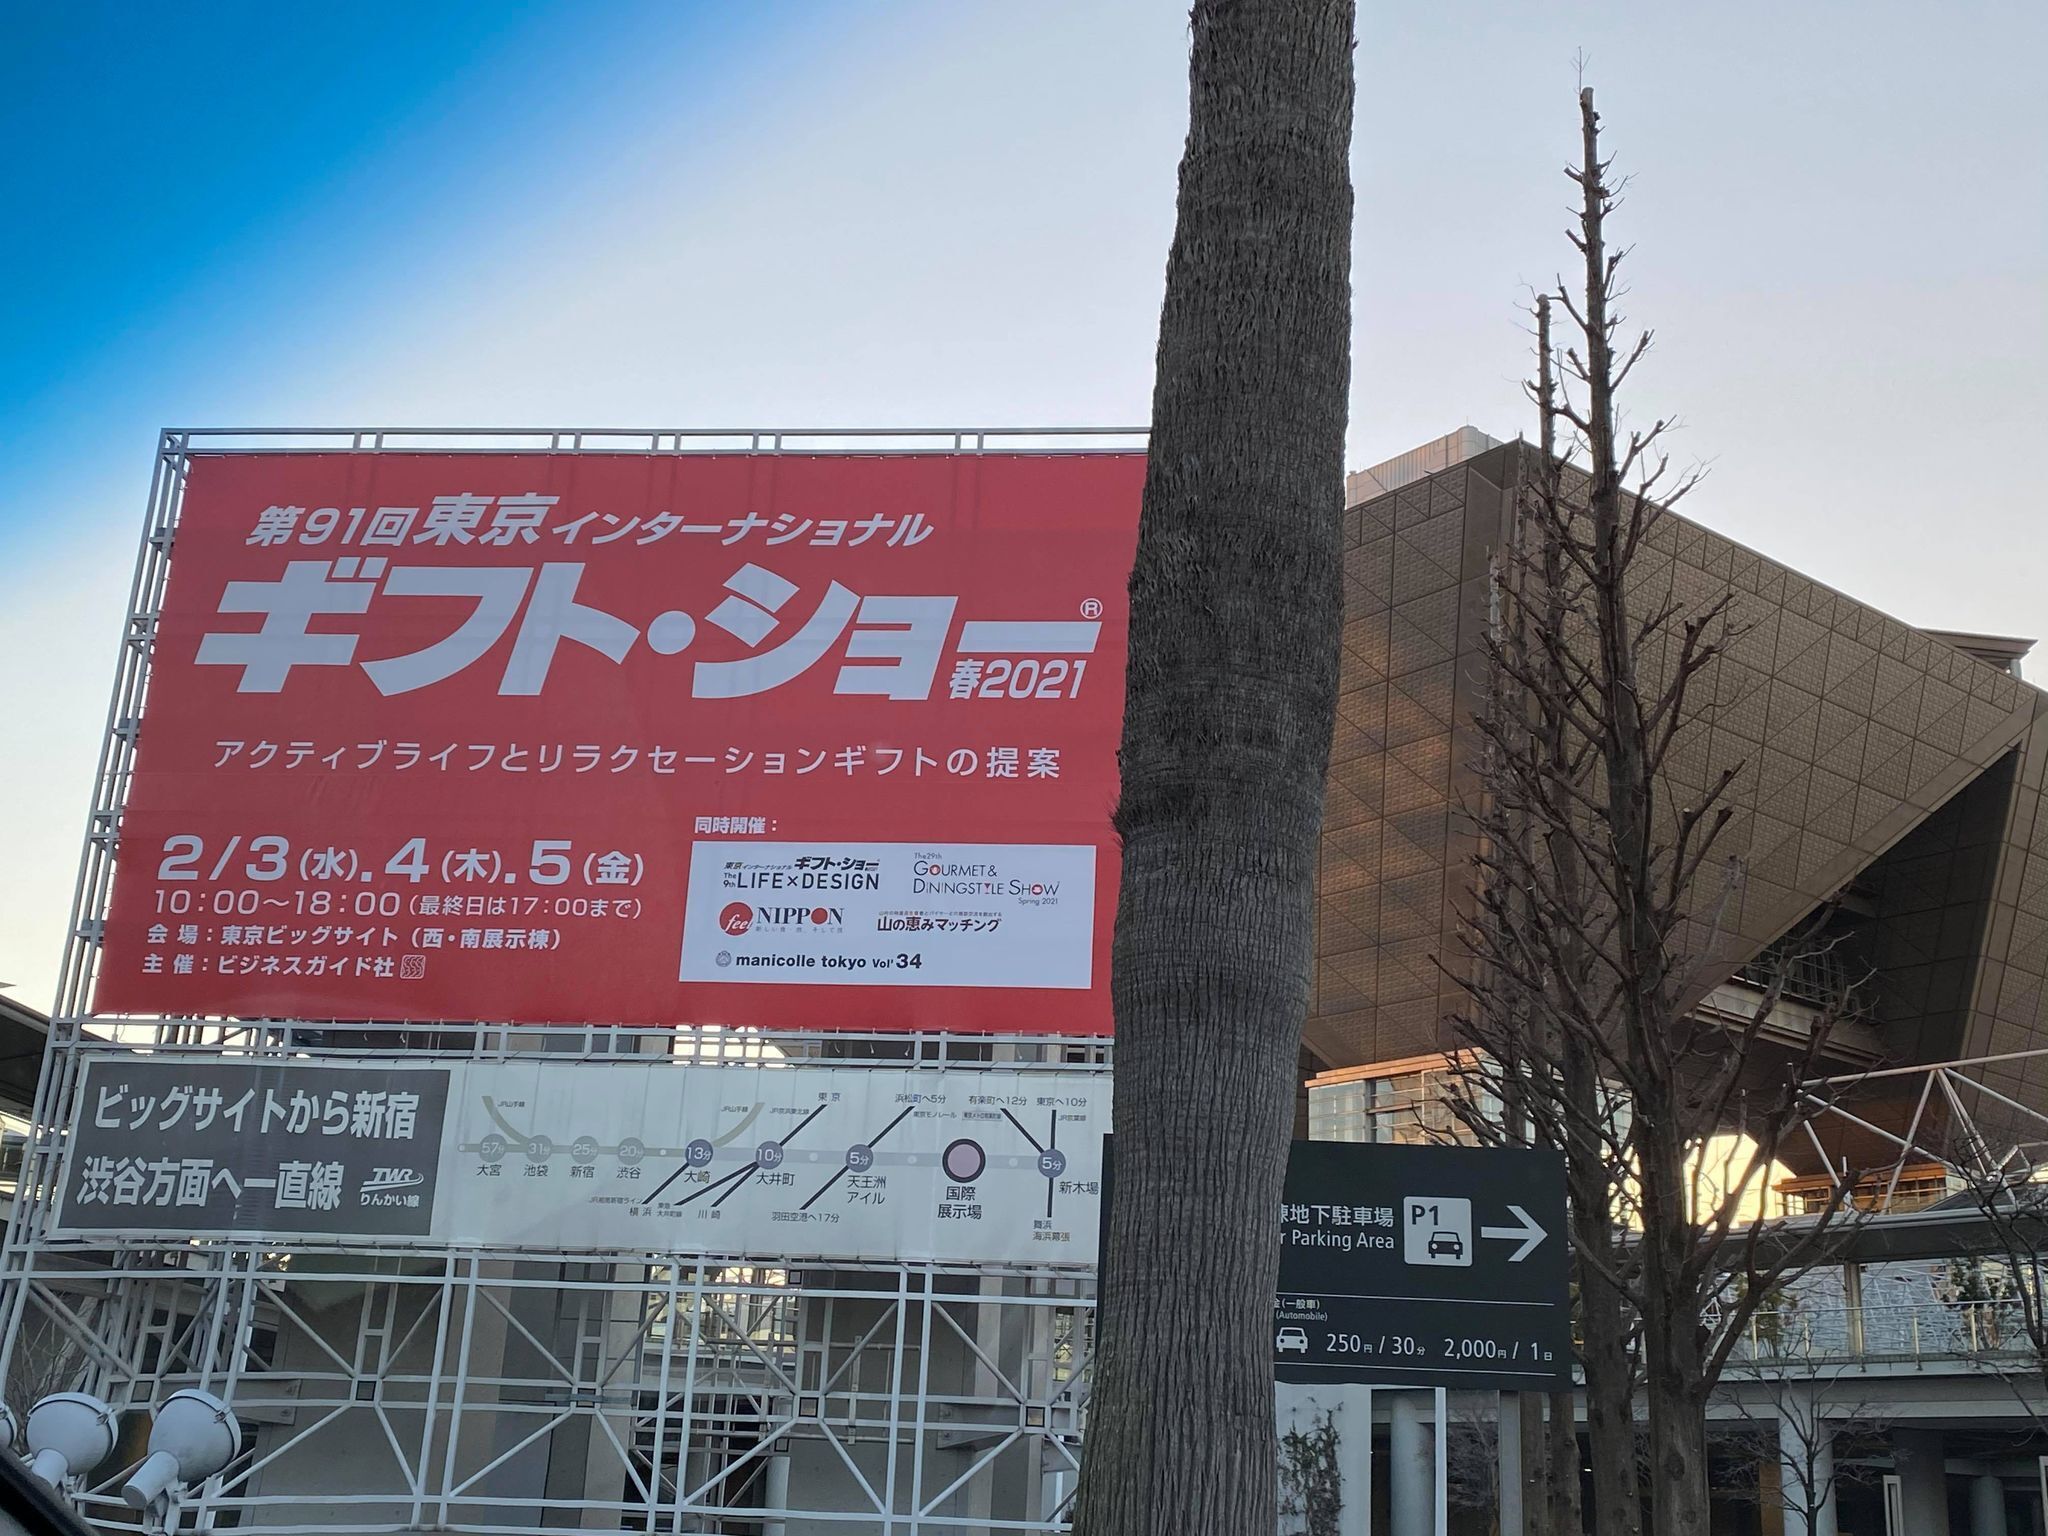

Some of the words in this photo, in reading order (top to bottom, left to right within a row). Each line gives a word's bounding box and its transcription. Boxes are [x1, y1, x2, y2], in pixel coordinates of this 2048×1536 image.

[194, 556, 1102, 700] ギフト・ショー
[949, 658, 1088, 700] 春2021
[213, 739, 1061, 779] アクティブライフとリラクセーションギフトの提案
[723, 880, 736, 888] 9th
[1018, 897, 1040, 906] Spring
[1042, 897, 1058, 905] 2021
[877, 916, 1003, 932] 山の恵みマッチング
[736, 954, 815, 967] manicolle
[821, 955, 867, 970] tokyo
[818, 1092, 840, 1101] 東京
[1036, 1097, 1087, 1107] 東京へ10分
[94, 1084, 420, 1139] ビッグサイトから新宿
[687, 1147, 711, 1160] 13分
[757, 1148, 782, 1162] 10分
[850, 1151, 870, 1165] 5分
[476, 1164, 502, 1177] 大宮
[523, 1164, 548, 1177] 池袋
[1042, 1157, 1062, 1170] 5分
[363, 1167, 413, 1184] TWR
[569, 1166, 595, 1178] 新宿
[616, 1167, 641, 1180] 渋谷
[684, 1171, 711, 1184] 大崎
[756, 1172, 795, 1186] 大井町
[76, 1155, 345, 1211] 渋谷方面へ一直線
[847, 1175, 887, 1189] 天王洲
[1059, 1181, 1099, 1195] 新木場
[360, 1193, 420, 1208] りんかい線
[847, 1191, 886, 1205] アイル
[946, 1186, 976, 1201] 国際
[937, 1204, 983, 1219] 展示場
[1411, 1205, 1439, 1226] P1
[1292, 1230, 1351, 1251] Parking
[1356, 1232, 1394, 1249] Area
